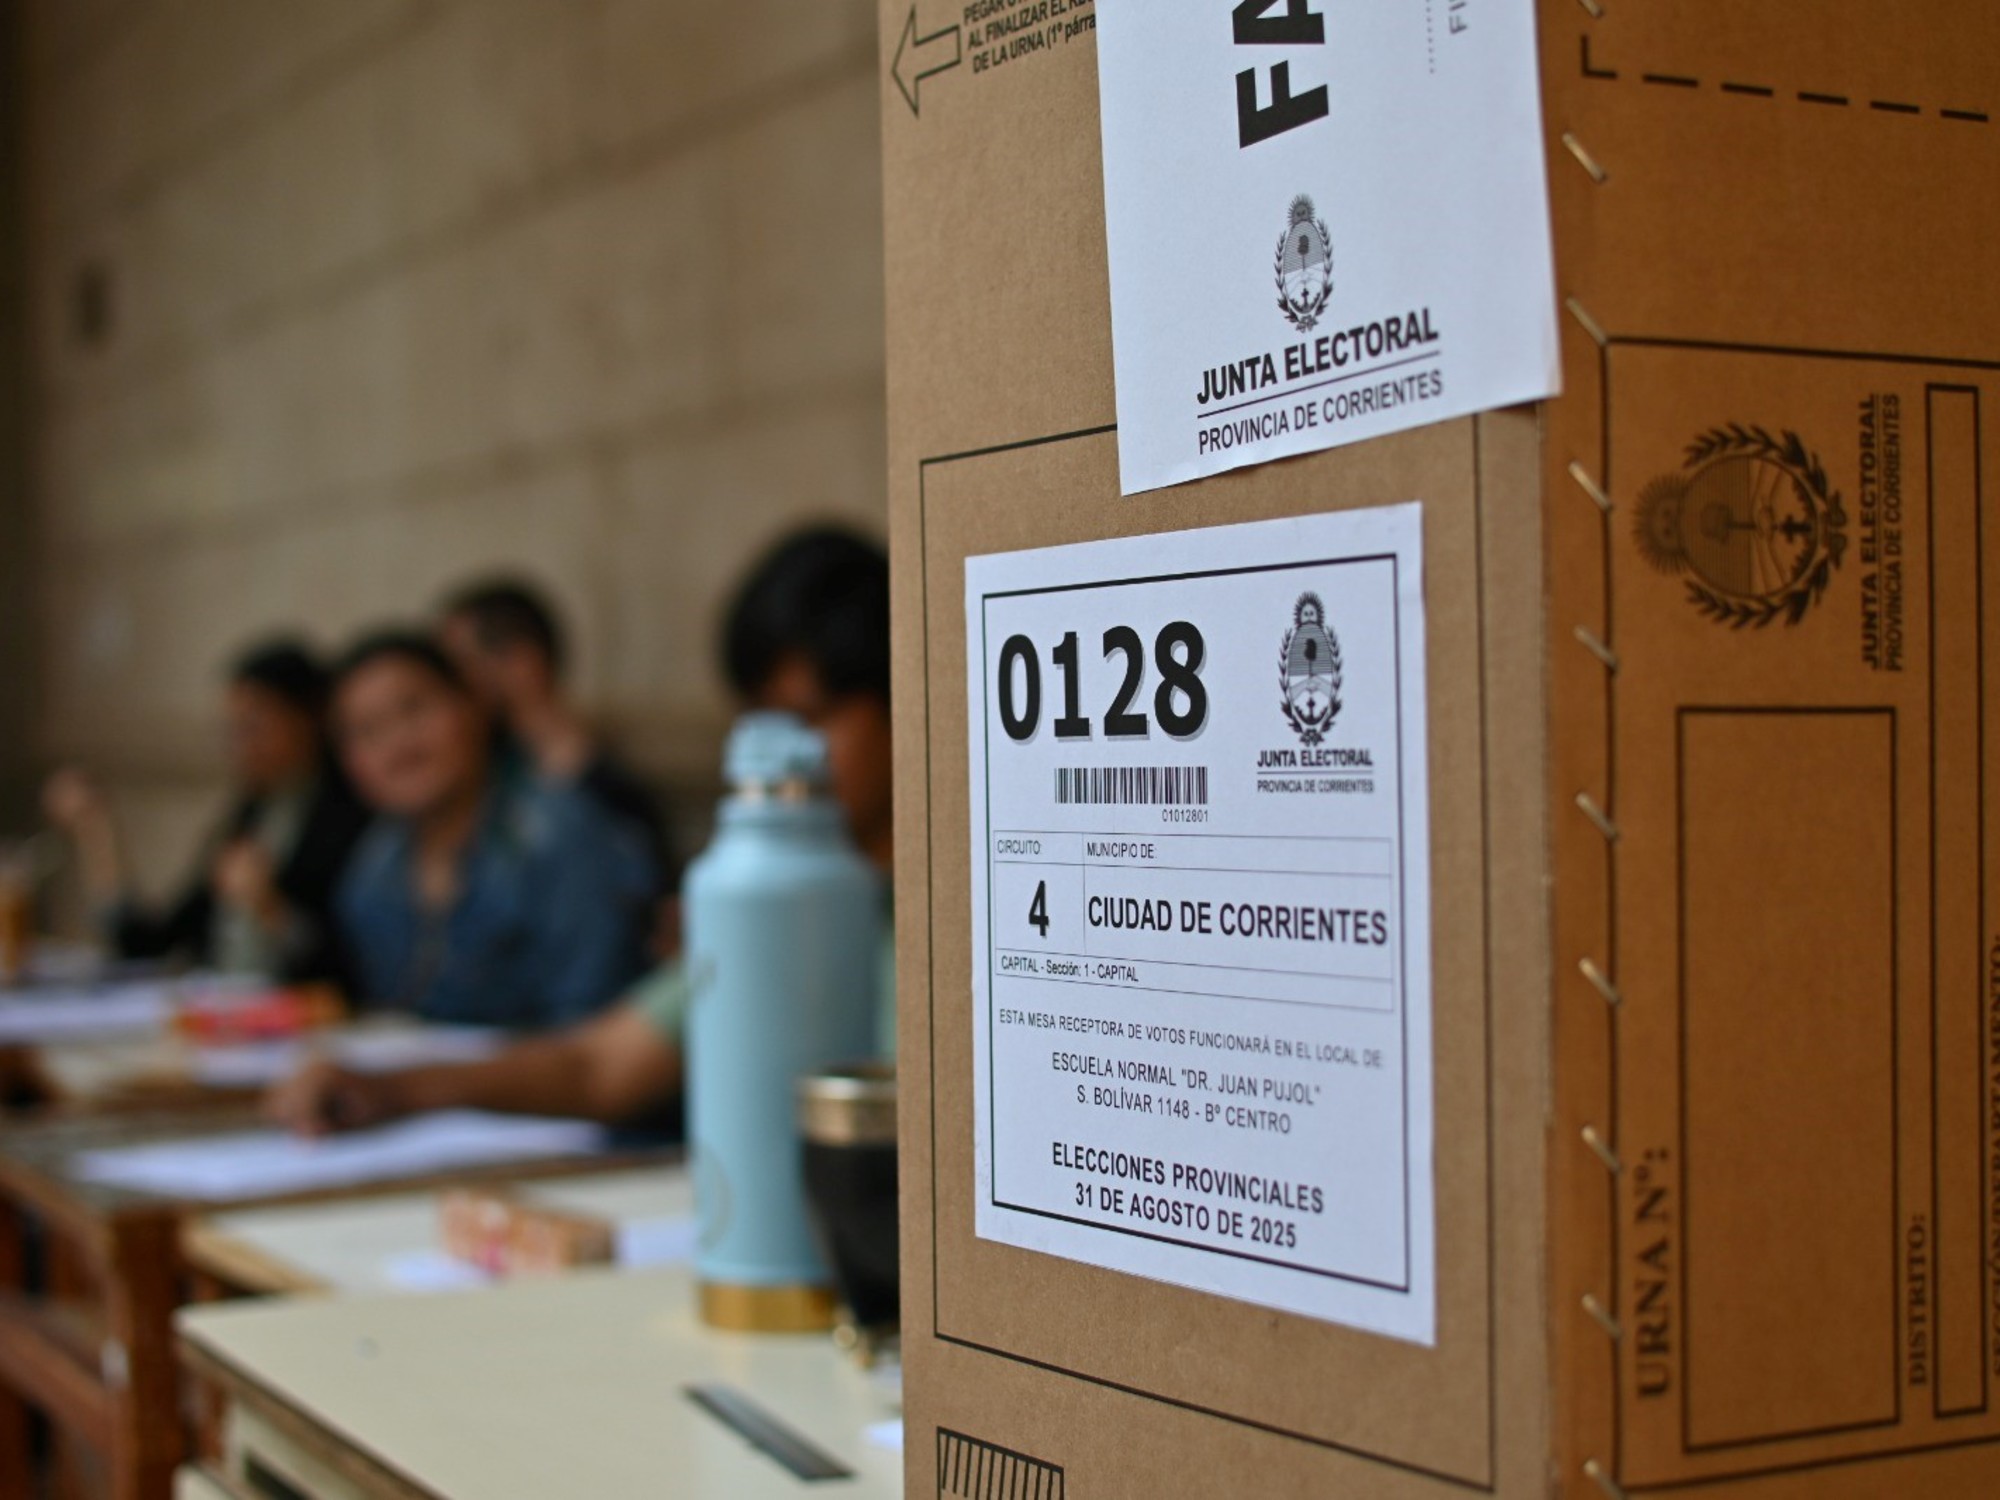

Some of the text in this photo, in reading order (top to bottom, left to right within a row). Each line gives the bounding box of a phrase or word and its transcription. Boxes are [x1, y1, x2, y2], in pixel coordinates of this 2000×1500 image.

[968, 28, 984, 50] AL
[985, 2, 1048, 42] FINALIZAR
[1050, 0, 1067, 17] EL
[972, 50, 990, 74] DE
[991, 44, 1008, 66] LA
[1009, 30, 1046, 59] URNA
[1197, 308, 1439, 404] JUNTA ELECTORAL
[1198, 369, 1443, 455] PROVINCIA DE CORRIENTES
[1859, 392, 1879, 670] JUNTA ELECTORAL
[1882, 392, 1902, 672] PROVINCIA DE CORRIENTES
[998, 621, 1208, 743] 0128
[1257, 748, 1374, 767] JUNTA ELECTORAL
[1257, 779, 1374, 793] PROVINCIA DE CORRIENTES
[1162, 809, 1209, 823] 01012801
[1028, 880, 1388, 945] 4 CIUDAD DE CORRIENTES
[1001, 955, 1038, 973] CAPITAL
[1097, 963, 1138, 982] CAPITAL
[1000, 1008, 1025, 1025] ESTA
[1028, 1012, 1056, 1029] MESA
[1059, 1015, 1124, 1037] RECEPTORA
[1128, 1023, 1142, 1039] DE
[1146, 1026, 1185, 1044] VOTOS
[1189, 1030, 1271, 1054] FUNCIONARÁ
[1275, 1039, 1292, 1057] EN
[1296, 1041, 1311, 1059] EL
[1316, 1044, 1358, 1065] LOCAL
[1052, 1052, 1113, 1078] ESCUELA
[1118, 1060, 1176, 1087] NORMAL
[1181, 1069, 1212, 1092] "DR.
[1218, 1073, 1257, 1097] JUAN
[1077, 1084, 1089, 1104] S.
[1094, 1086, 1152, 1114] BOLÍVAR
[1157, 1096, 1190, 1120] 1148
[1225, 1105, 1291, 1134] CENTRO
[1052, 1142, 1324, 1214] ELECCIONES PROVINCIALES
[1075, 1182, 1296, 1249] 31 DE AGOSTO DE 2025
[1636, 1238, 1670, 1399] URNA
[1908, 1213, 1927, 1387] DISTRITO:
